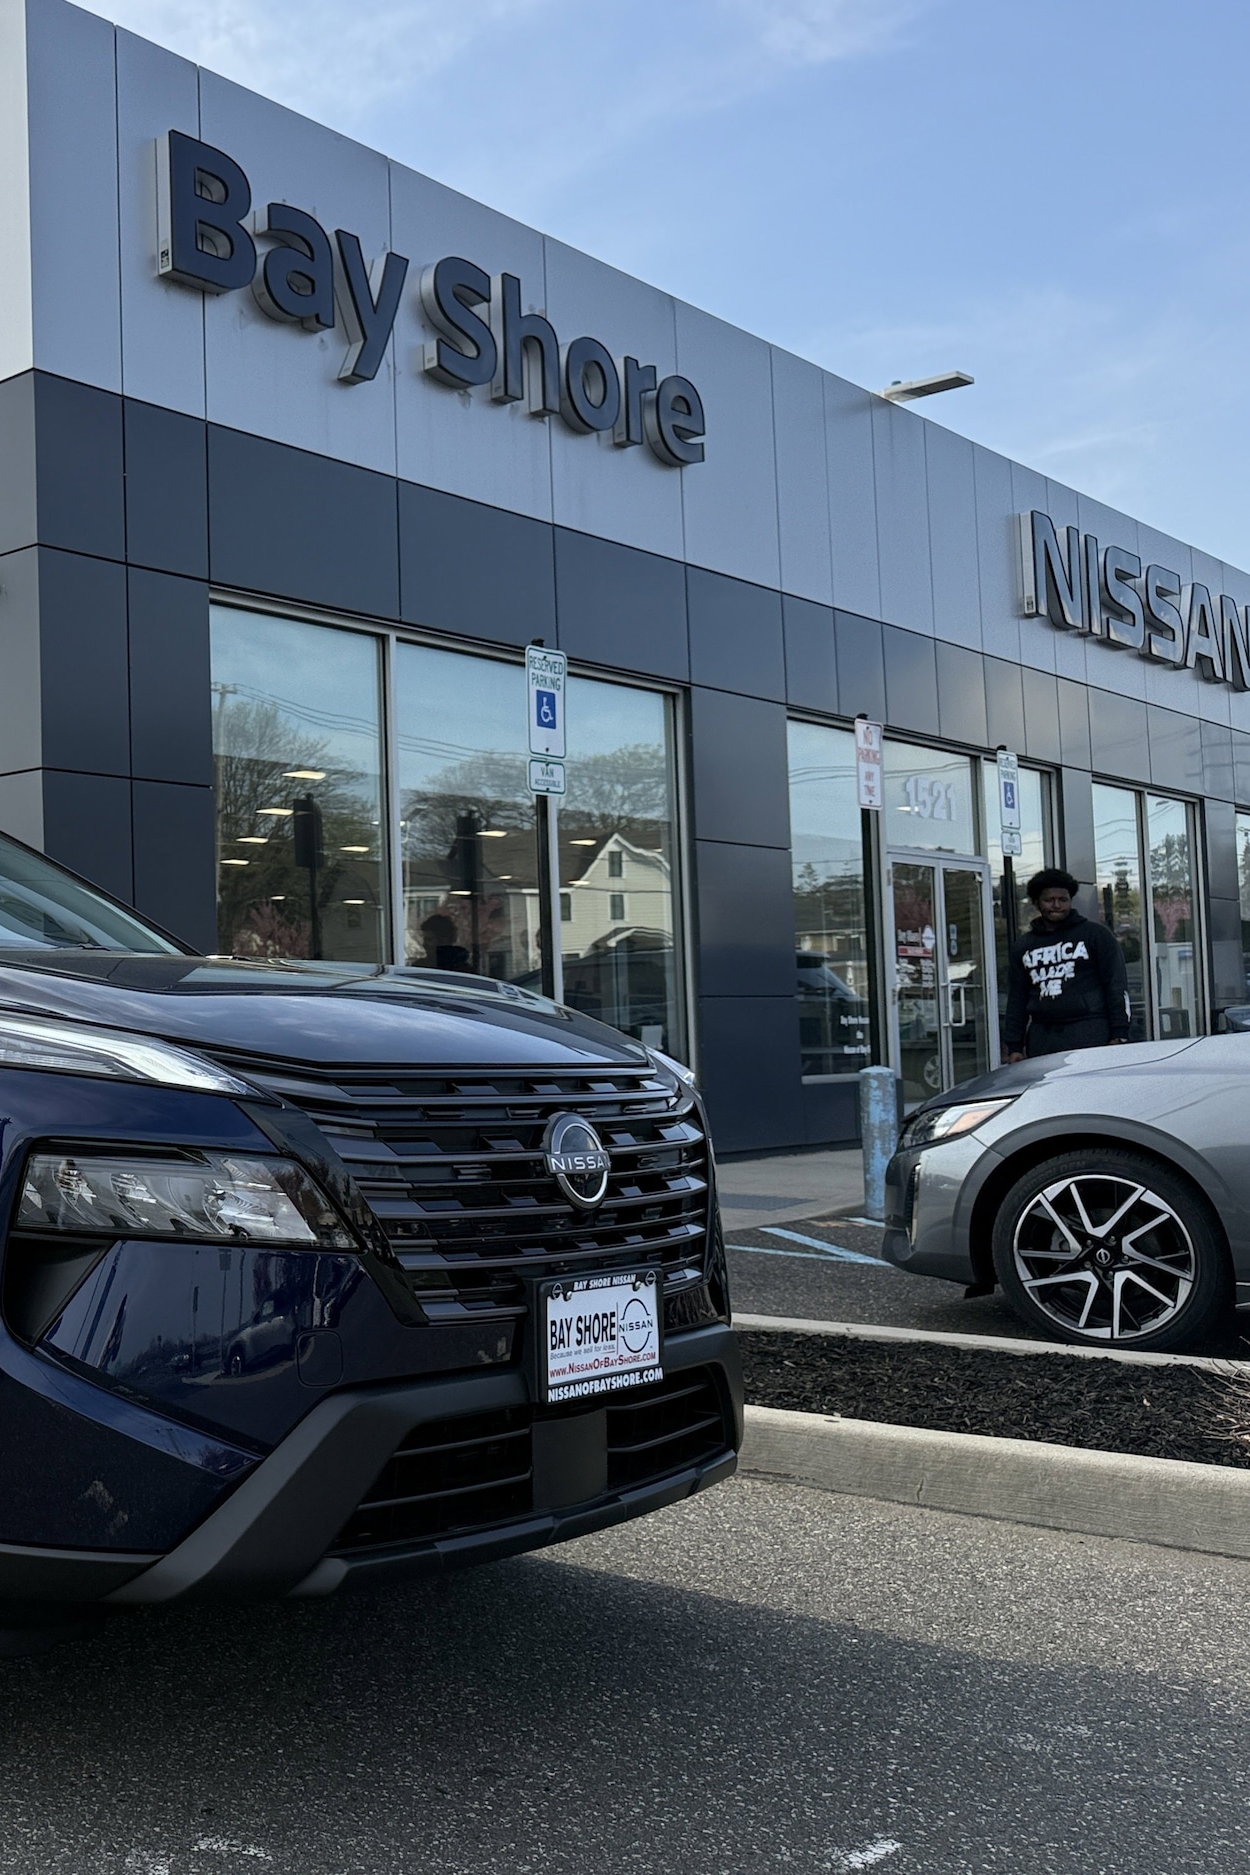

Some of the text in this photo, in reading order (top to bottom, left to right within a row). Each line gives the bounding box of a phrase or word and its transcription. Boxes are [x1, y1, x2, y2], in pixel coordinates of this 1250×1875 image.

[154, 129, 705, 467] Bay Shore
[1020, 509, 1250, 692] NISSAN
[529, 655, 564, 675] RESERVED
[531, 672, 561, 691] PARKING
[540, 766, 555, 778] VAN
[905, 776, 957, 820] 1521
[1022, 941, 1089, 968] AFRICA
[1030, 961, 1075, 984] MADE
[1040, 979, 1062, 998] ME
[550, 1156, 612, 1170] NISSAN
[573, 1274, 637, 1291] BAY SHORE NISSAN
[550, 1311, 616, 1350] BAY SHORE
[619, 1319, 653, 1332] NISSAN
[550, 1349, 573, 1360] Because
[548, 1367, 663, 1403] NISSANOFBAYSHORE.COM
